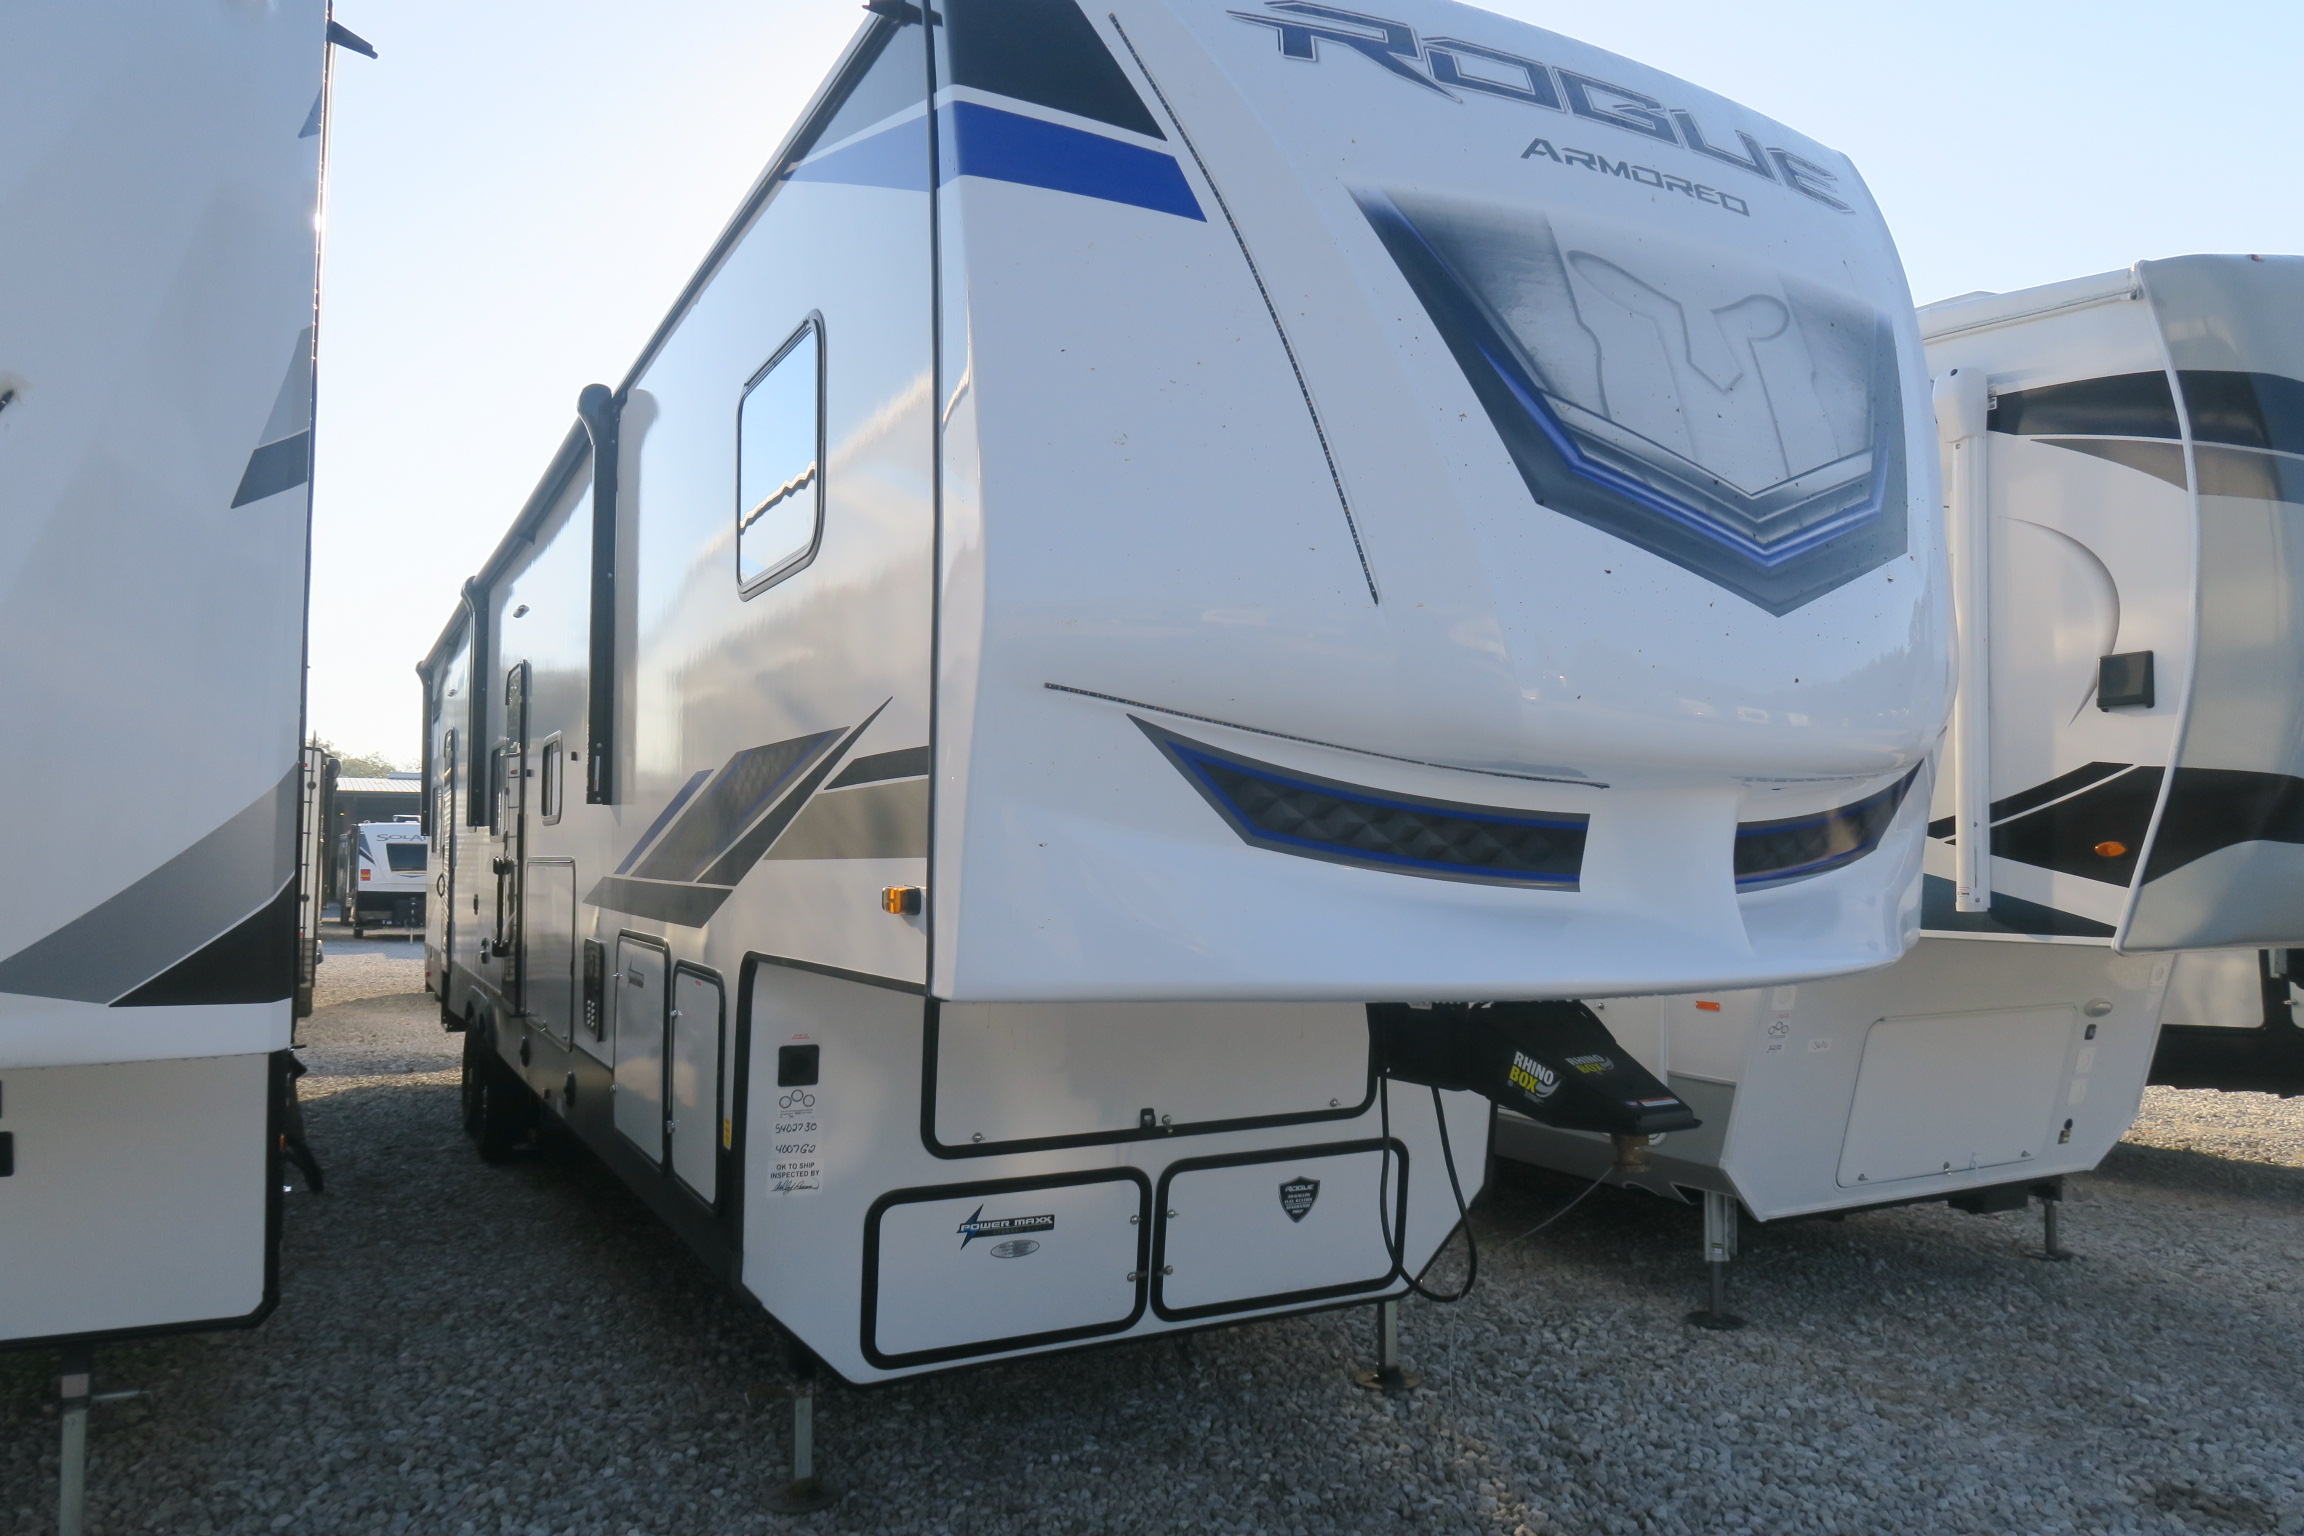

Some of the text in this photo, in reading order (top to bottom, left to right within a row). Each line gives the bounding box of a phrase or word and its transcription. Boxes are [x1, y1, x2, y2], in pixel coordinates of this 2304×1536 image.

[1226, 0, 1855, 213] ROGUE
[1521, 138, 1750, 217] ARMORED
[1513, 1050, 1554, 1085] RHINO
[1565, 1054, 1605, 1064] RHINO
[1575, 1064, 1606, 1073] BOX
[1509, 1065, 1539, 1093] BOX
[770, 1171, 809, 1179] INSPECTED
[961, 1216, 1053, 1231] POWER MAXX
